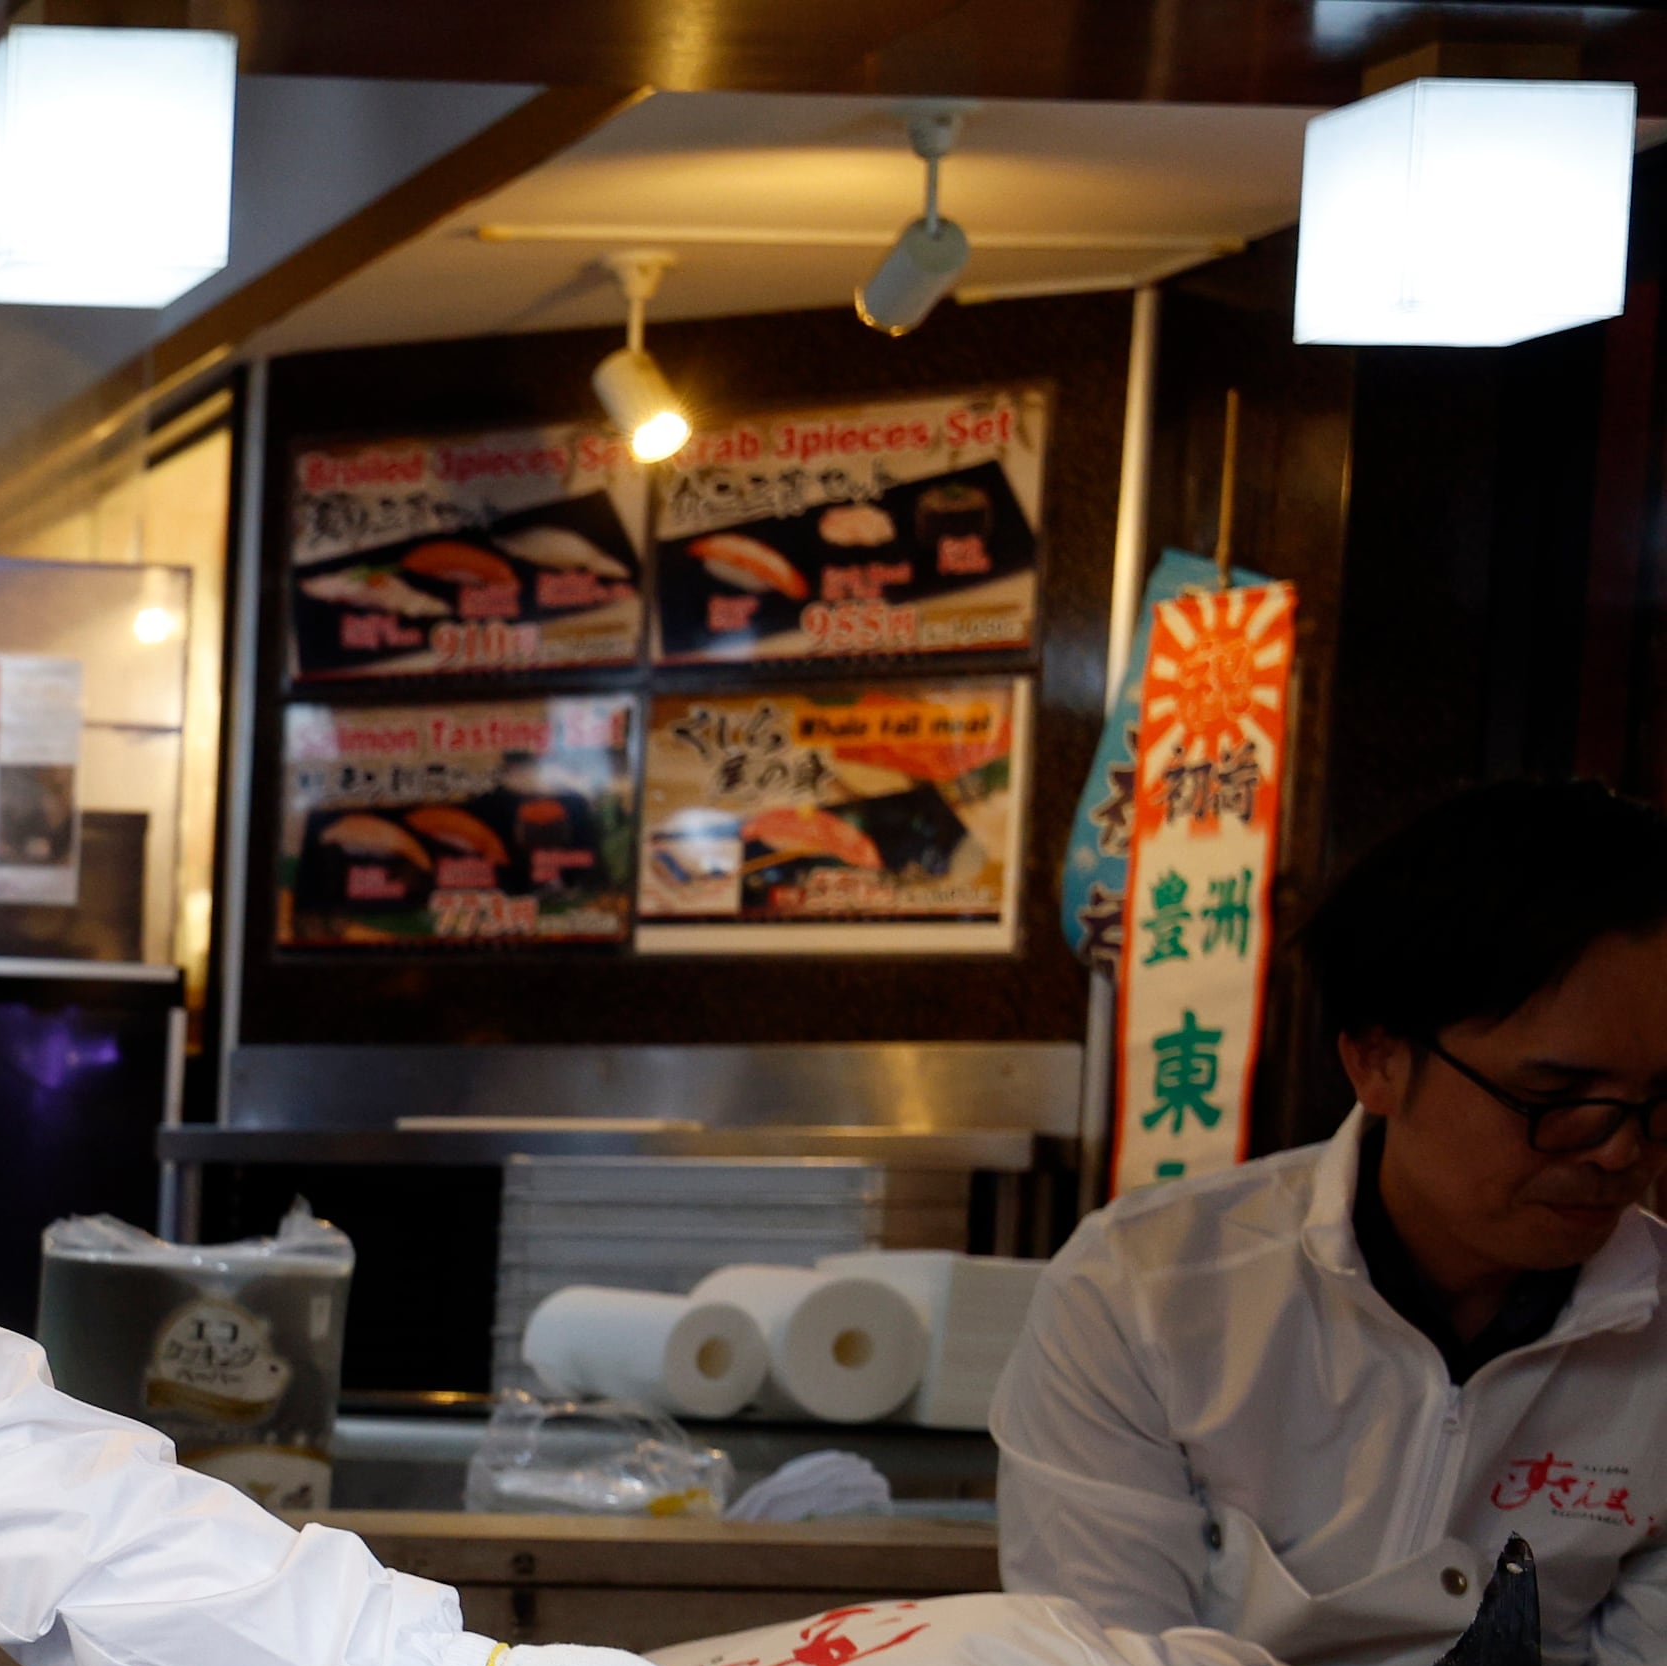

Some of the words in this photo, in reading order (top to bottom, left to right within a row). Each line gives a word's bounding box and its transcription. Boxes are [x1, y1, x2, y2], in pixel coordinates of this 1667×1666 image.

[775, 421, 931, 464] 3pieces
[945, 408, 1012, 445] Set
[1155, 740, 1261, 826] 初荷
[1141, 868, 1254, 967] 豊洲
